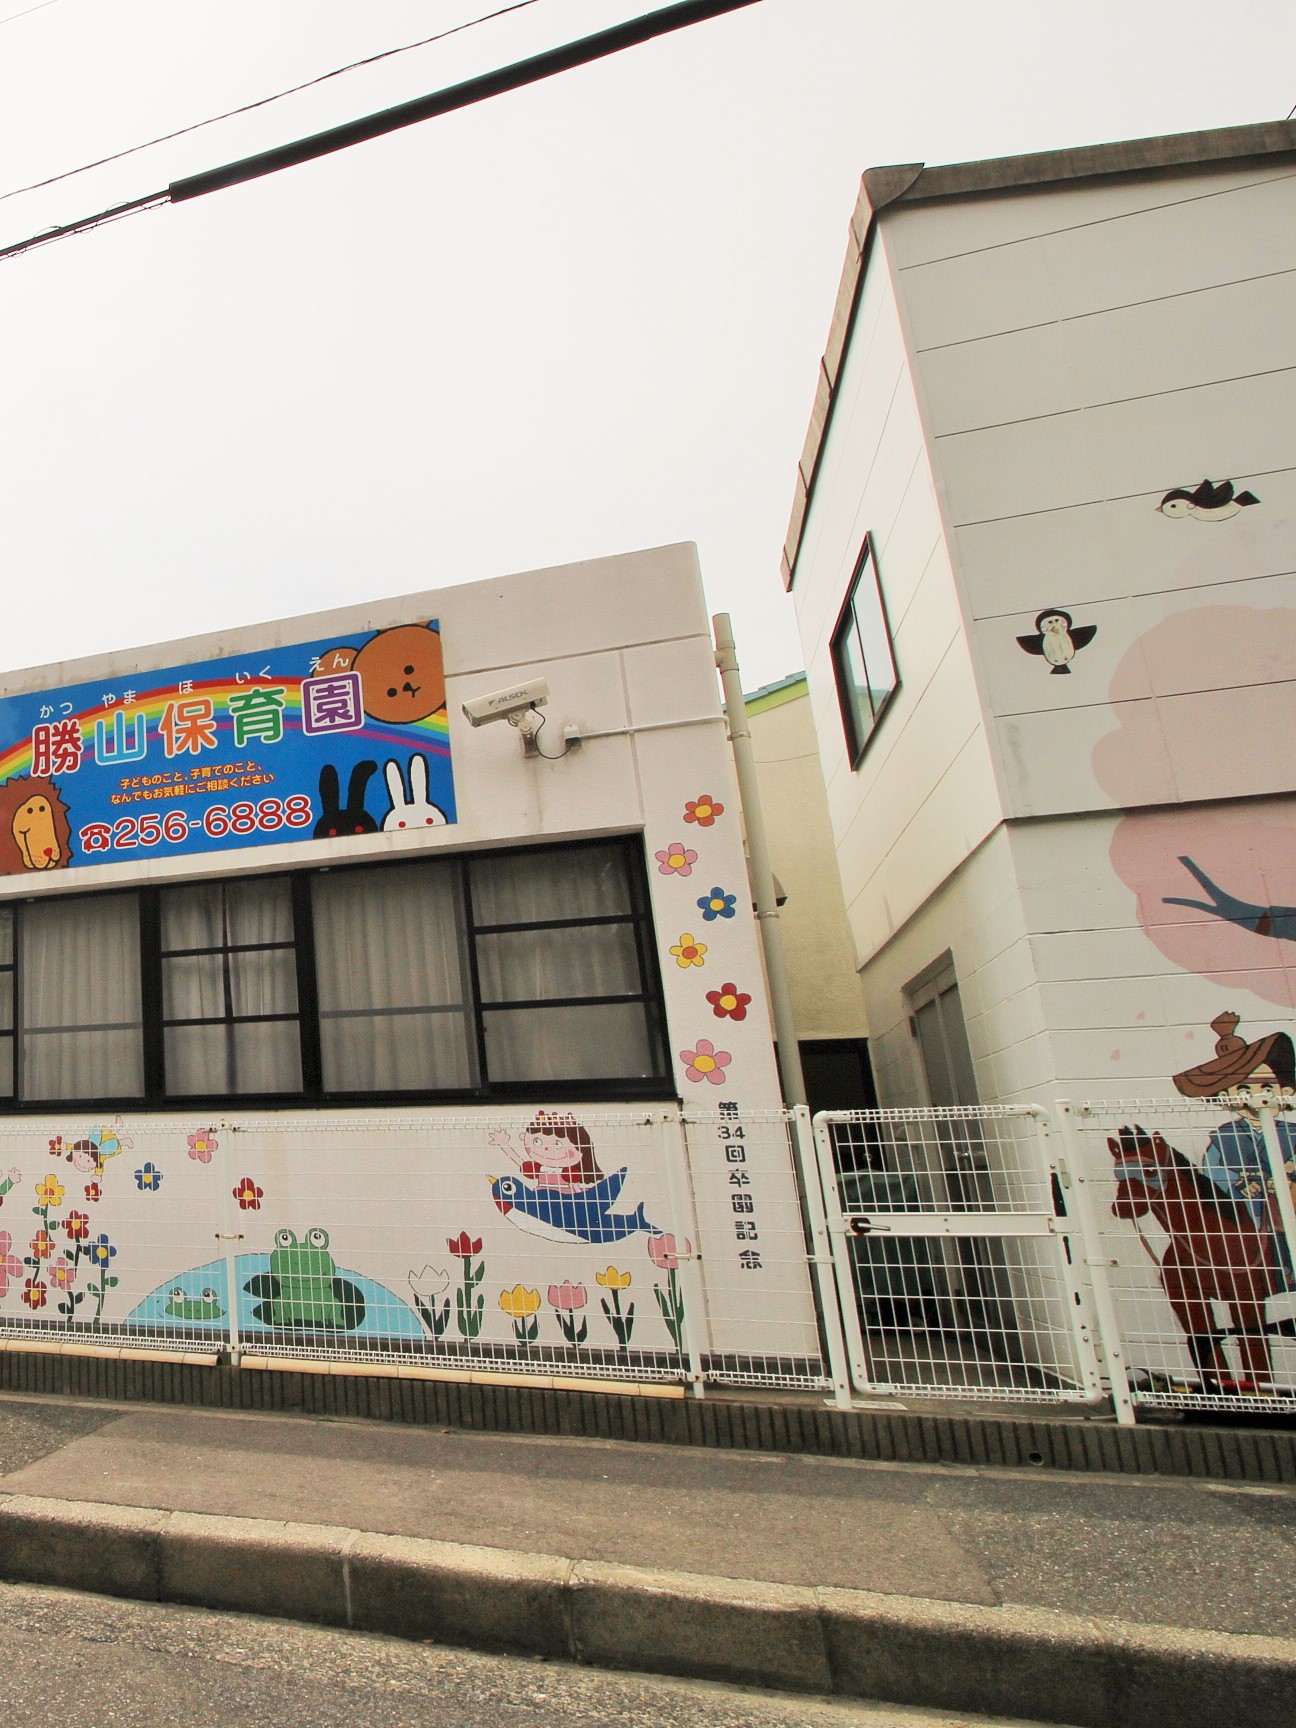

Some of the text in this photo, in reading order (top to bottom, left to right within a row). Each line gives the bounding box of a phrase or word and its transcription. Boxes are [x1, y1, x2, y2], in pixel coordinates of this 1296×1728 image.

[39, 655, 351, 720] かつ やま ほ いく えん
[497, 689, 529, 705] ALSOK
[31, 671, 364, 777] 勝山保育園
[110, 772, 275, 805] なんでもお気軽にご相談ください
[119, 760, 263, 790] 子どものこと、子育てのこと、
[113, 795, 313, 850] 256-6888
